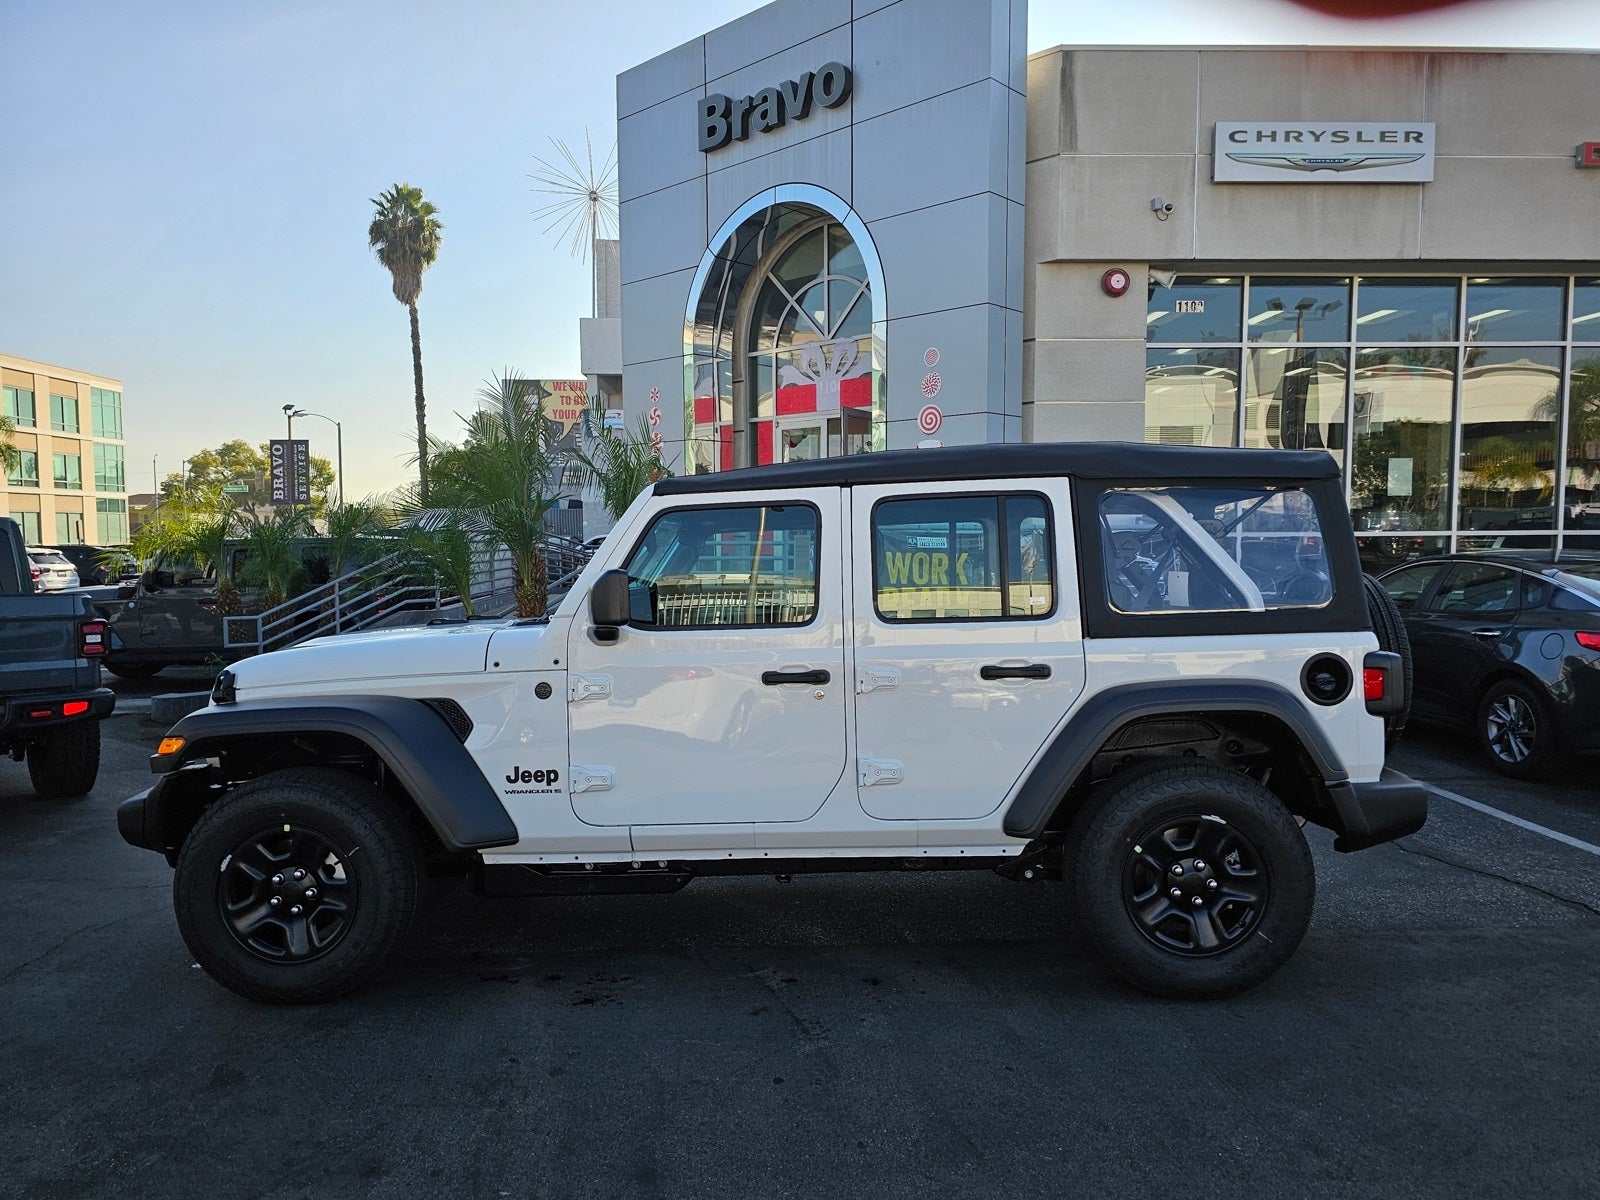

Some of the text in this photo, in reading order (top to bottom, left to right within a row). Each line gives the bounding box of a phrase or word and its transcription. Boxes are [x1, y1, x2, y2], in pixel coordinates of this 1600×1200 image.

[698, 61, 853, 153] Bravo
[1228, 130, 1425, 144] CHRYSLER
[552, 381, 567, 391] WE
[560, 395, 571, 405] TO
[552, 409, 577, 419] YOUR
[272, 444, 284, 500] BRAVO
[298, 444, 307, 500] SERVICE
[885, 551, 969, 585] WORK
[505, 766, 559, 786] Jeep
